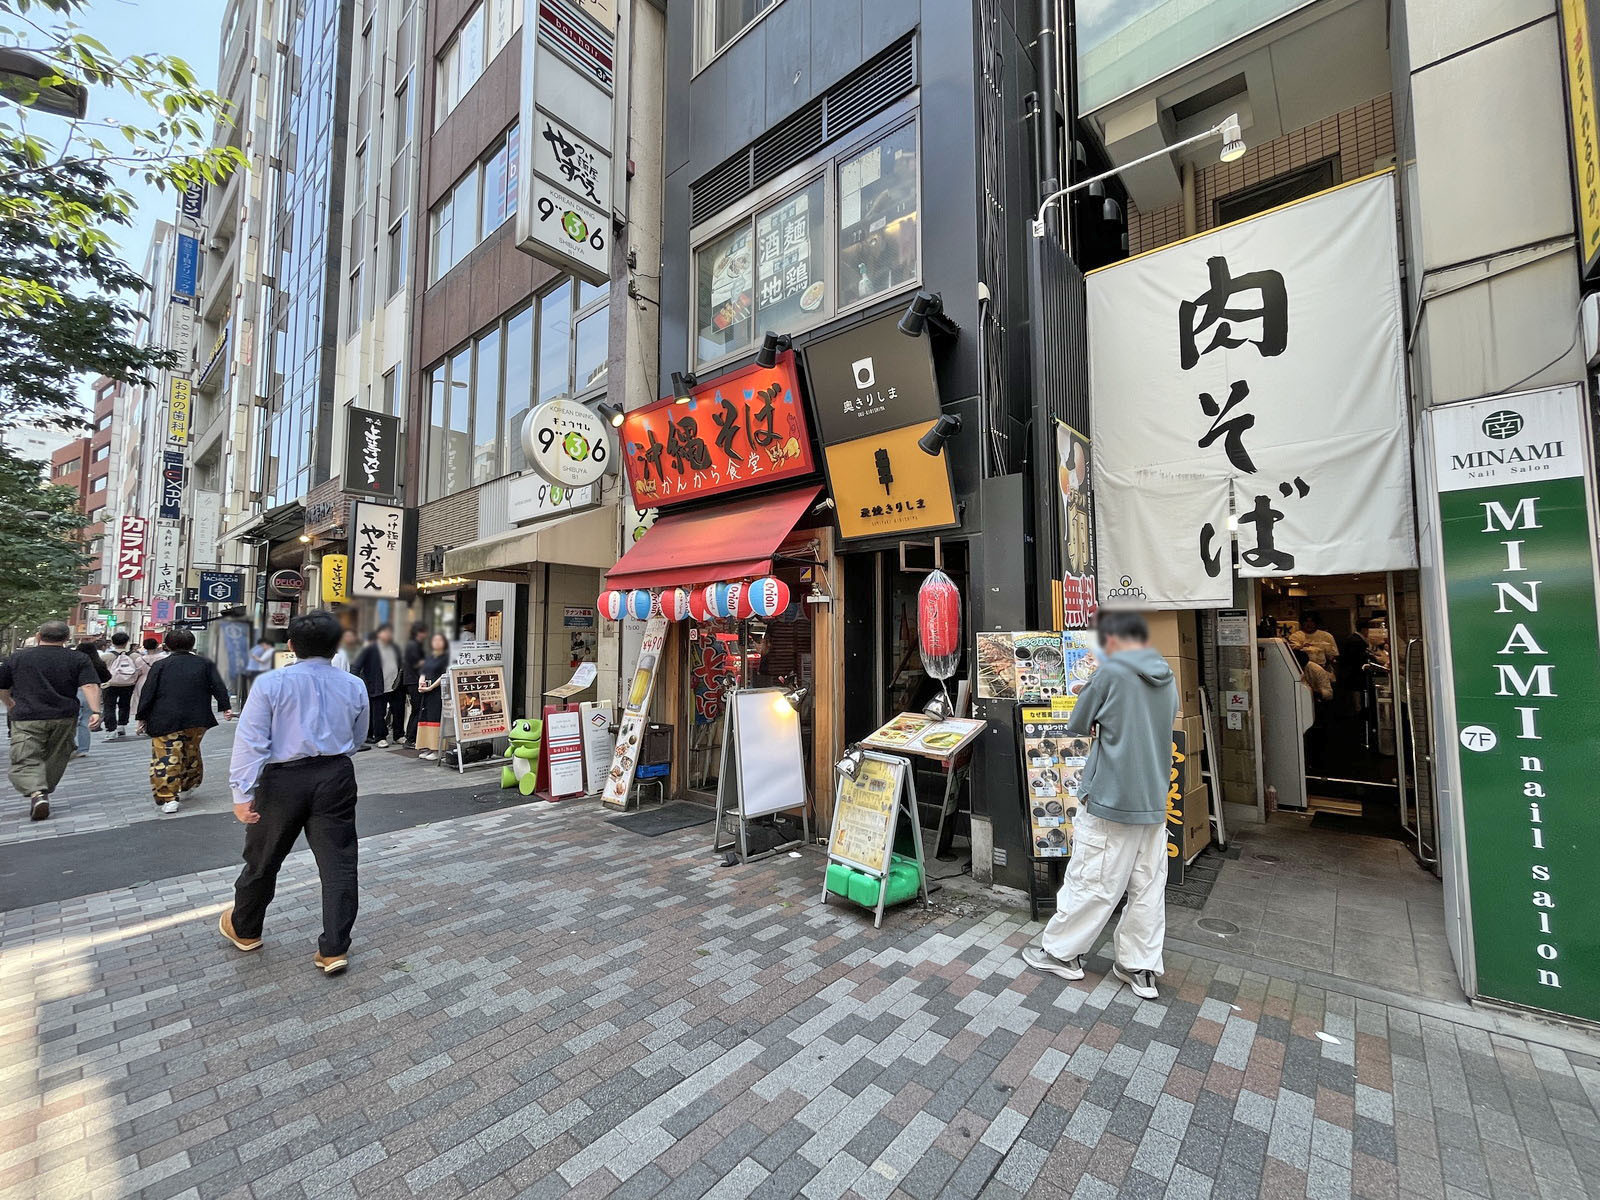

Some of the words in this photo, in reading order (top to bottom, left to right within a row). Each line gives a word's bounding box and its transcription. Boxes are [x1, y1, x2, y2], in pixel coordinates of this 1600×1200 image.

[542, 121, 601, 205] やすべえ
[550, 190, 575, 208] KOREAN
[575, 203, 596, 220] DINING
[558, 237, 585, 255] SHIBUYA
[172, 381, 188, 433] おおの歯科
[549, 405, 574, 417] KOREAN
[574, 411, 594, 420] DINING
[843, 386, 898, 414] 奥きりしま
[1178, 255, 1311, 578] 肉そば
[169, 434, 184, 443] 4F
[634, 382, 783, 483] 沖縄そば
[562, 465, 588, 474] SHIBUYA
[1450, 440, 1566, 471] MINAMI
[163, 463, 184, 508] LUXAS
[661, 454, 764, 495] かんから食堂
[1468, 470, 1496, 479] Nail
[1510, 463, 1550, 474] Salon
[119, 517, 144, 579] カラオケ
[359, 522, 386, 592] やすべえ
[727, 585, 740, 610] Orion
[764, 582, 778, 608] Orion
[1479, 497, 1558, 740] MINAMI
[477, 653, 502, 662] 大歓迎
[462, 683, 496, 691] ストレッチ
[1464, 732, 1493, 747] 7F
[1519, 756, 1546, 850] nail
[1531, 864, 1562, 988] salon
